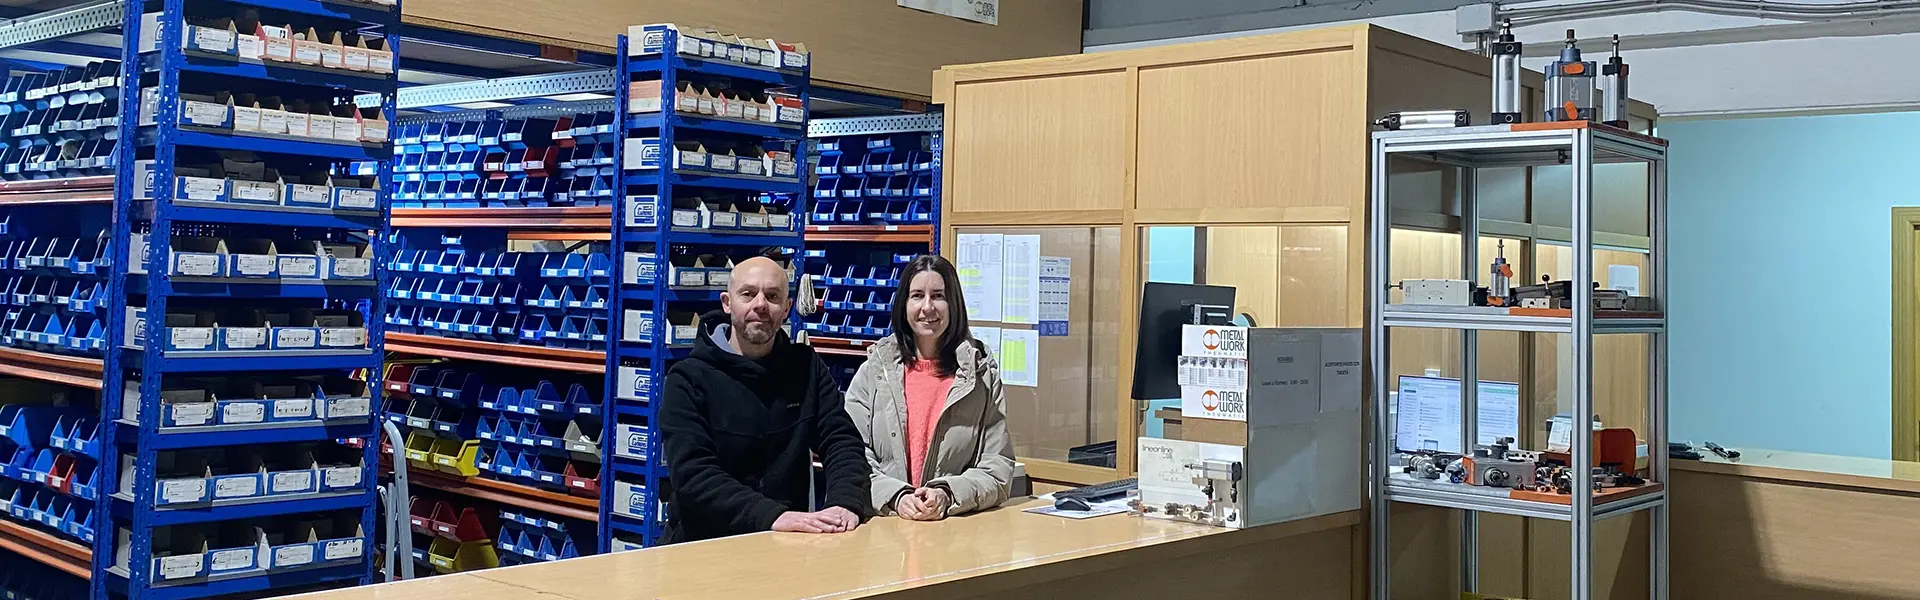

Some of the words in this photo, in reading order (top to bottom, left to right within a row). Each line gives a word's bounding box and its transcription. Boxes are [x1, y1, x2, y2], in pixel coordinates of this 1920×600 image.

[1220, 329, 1244, 341] METAL
[1220, 340, 1245, 352] WORK
[1219, 391, 1243, 403] METAL
[1219, 402, 1244, 413] WORK
[1202, 411, 1245, 419] PNEUMATIC
